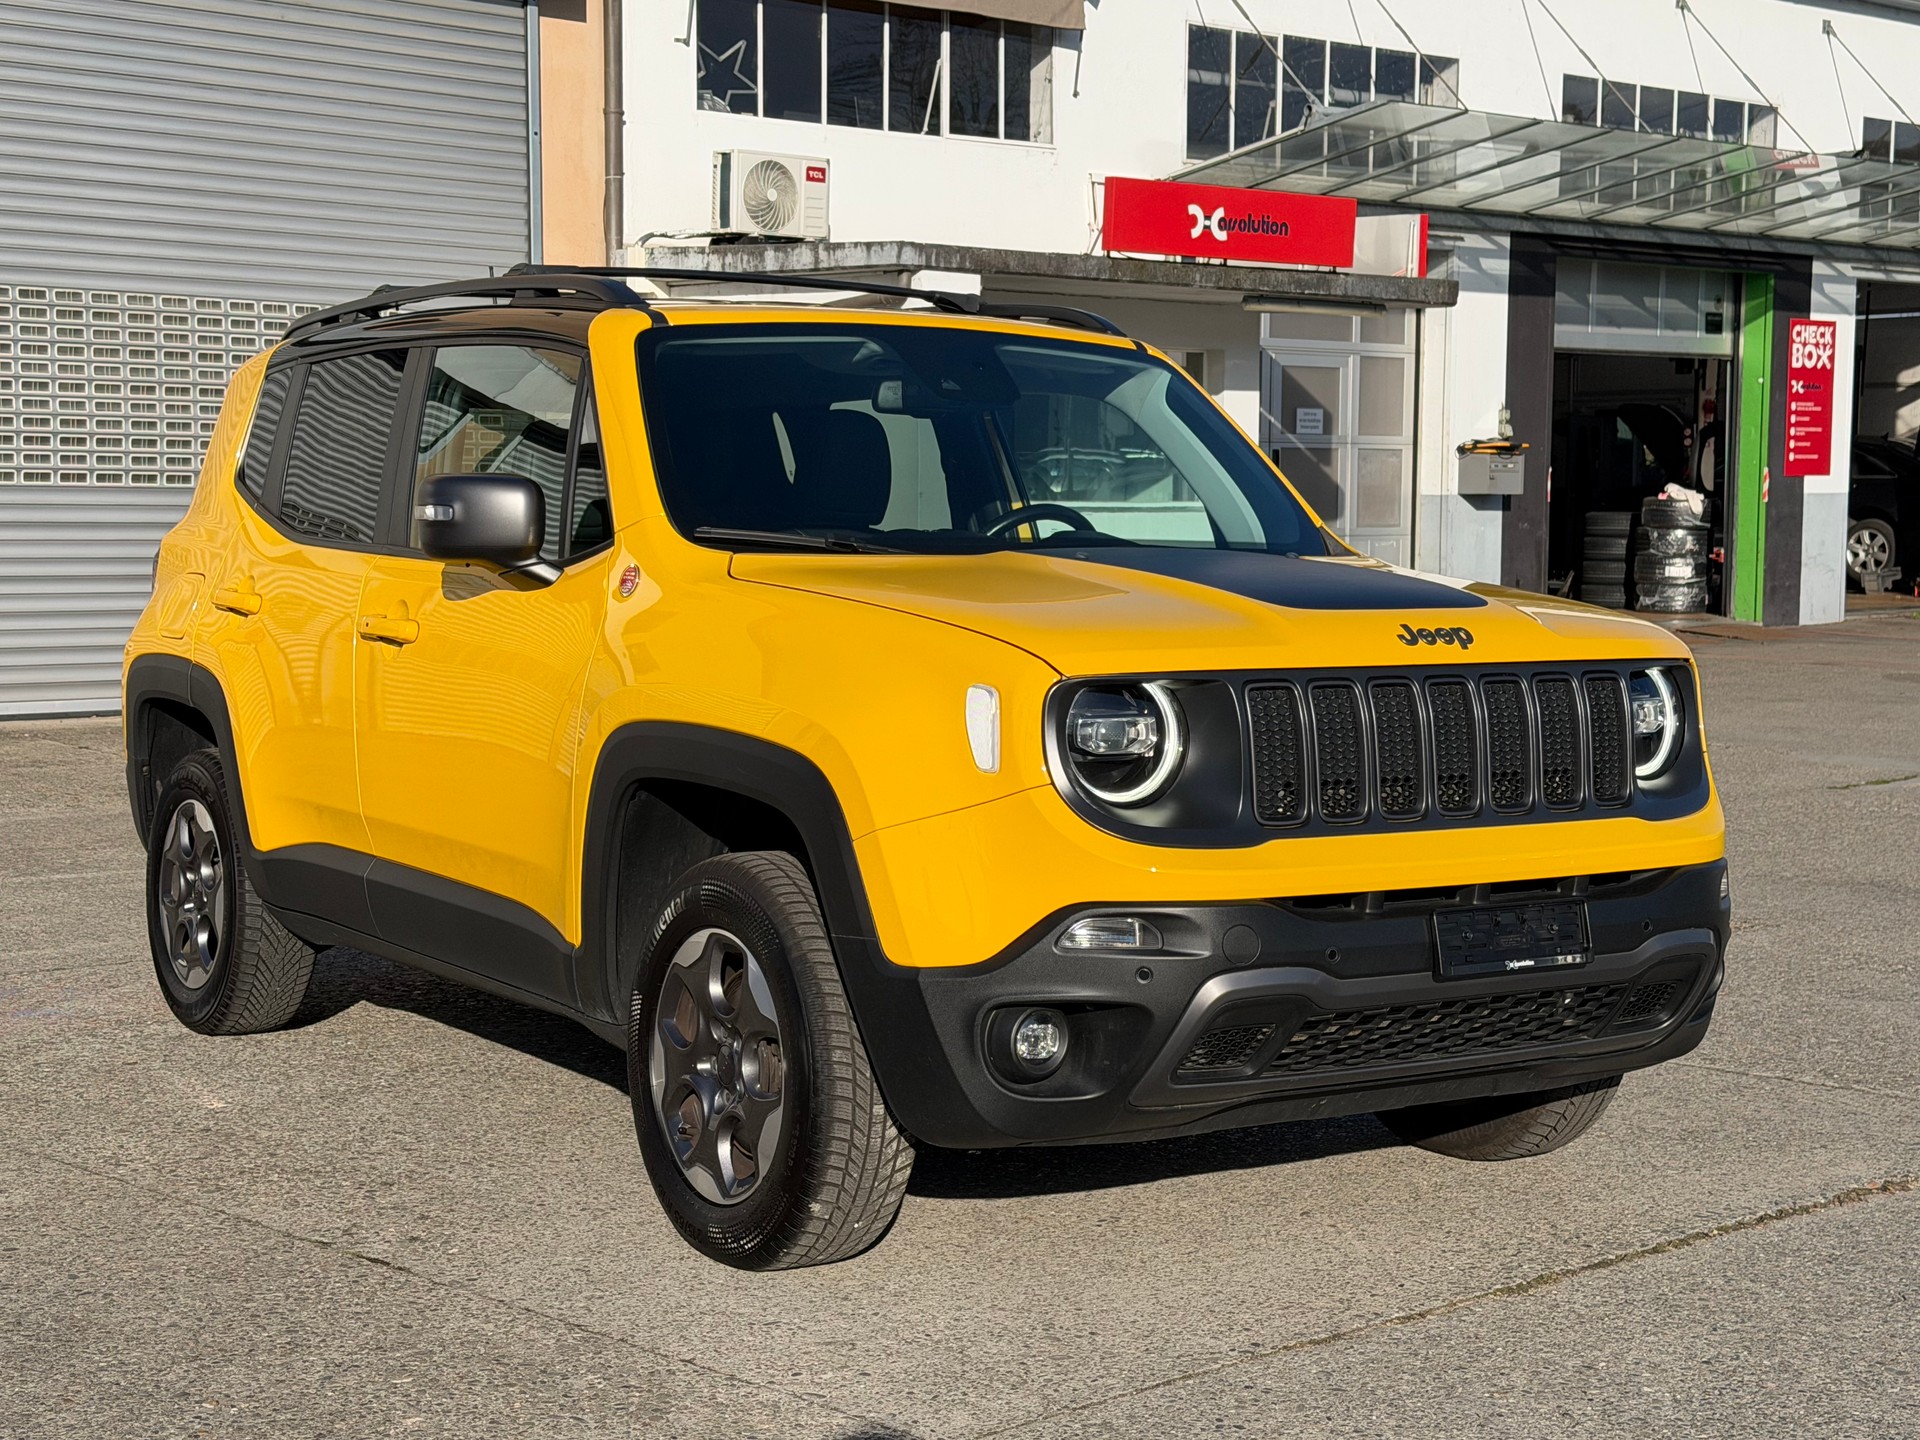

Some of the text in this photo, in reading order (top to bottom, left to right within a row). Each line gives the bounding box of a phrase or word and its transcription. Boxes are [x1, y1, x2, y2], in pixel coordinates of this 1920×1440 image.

[808, 170, 824, 179] TCL
[1792, 324, 1834, 344] CHECK
[1791, 343, 1833, 370] BOX
[1396, 624, 1474, 650] Jeep
